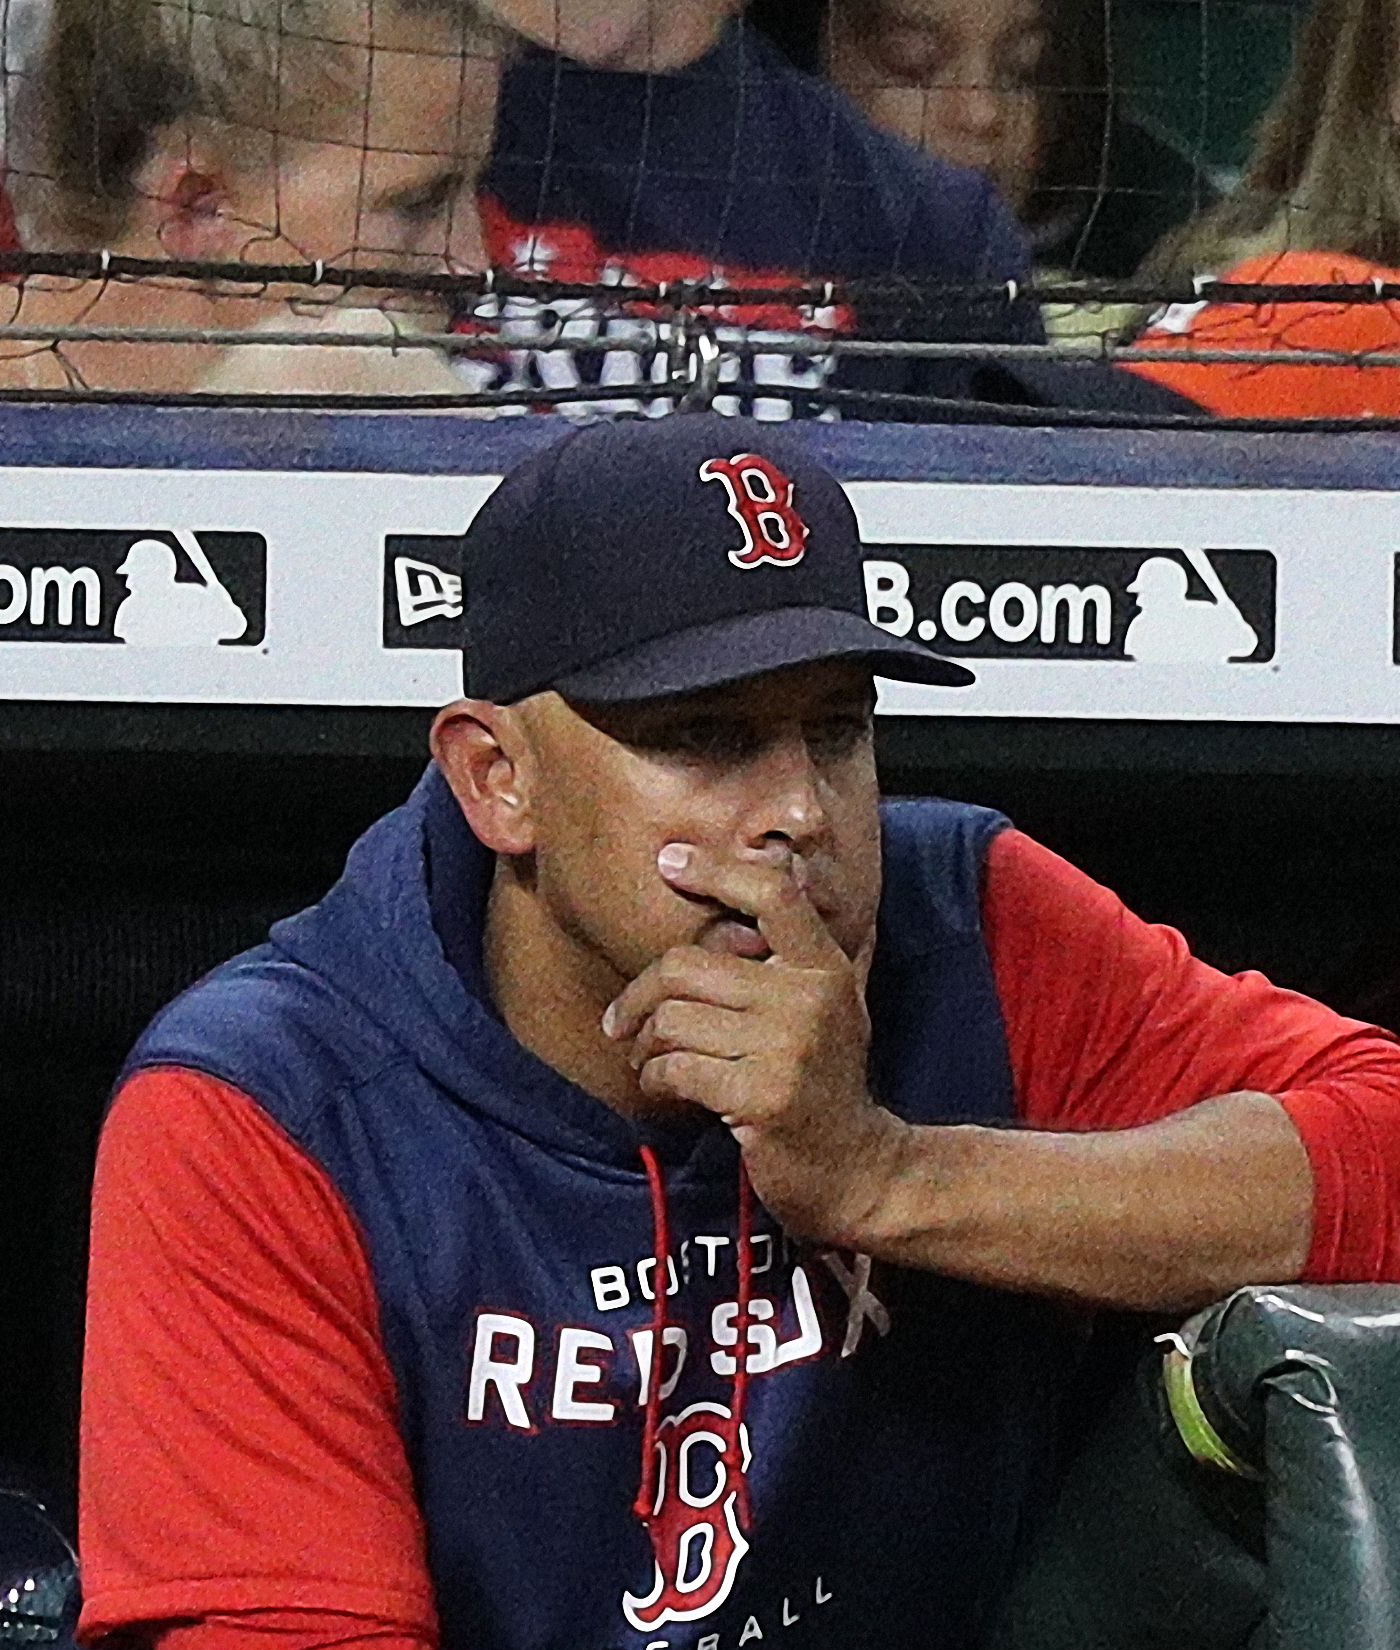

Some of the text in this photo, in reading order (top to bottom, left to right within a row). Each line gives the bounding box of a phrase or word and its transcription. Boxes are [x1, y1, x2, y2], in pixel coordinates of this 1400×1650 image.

[699, 453, 810, 570] B
[465, 1309, 690, 1433] RED
[622, 1400, 753, 1633] B
